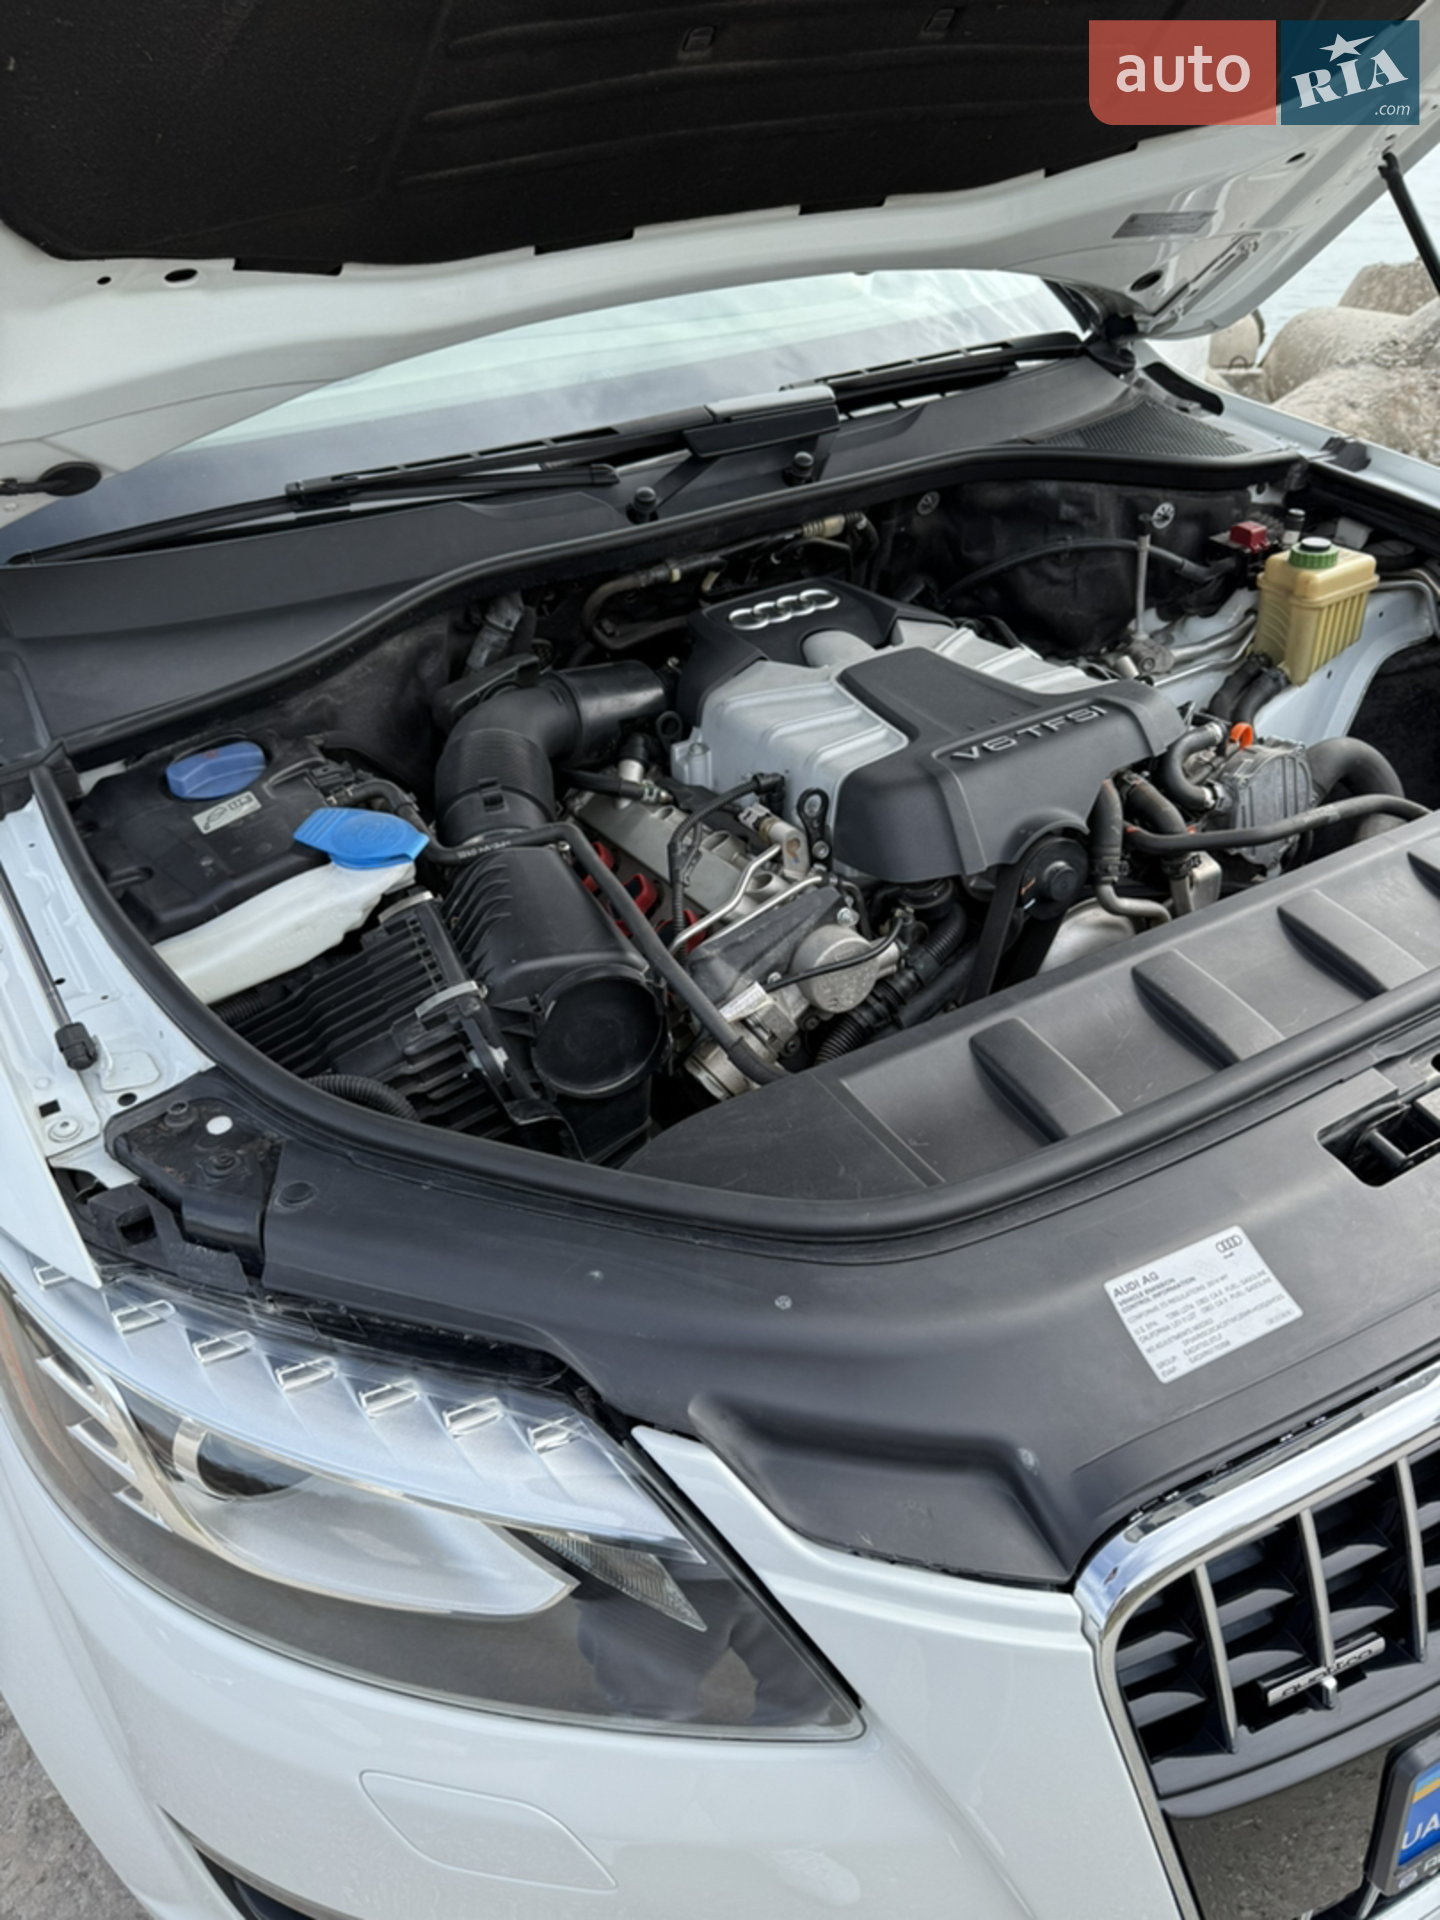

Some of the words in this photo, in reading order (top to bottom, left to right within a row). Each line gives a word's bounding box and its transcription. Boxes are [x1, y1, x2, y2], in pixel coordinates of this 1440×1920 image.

[949, 734, 1018, 761] V6
[1016, 704, 1108, 739] TFSI
[1110, 1278, 1141, 1299] AUDI
[1139, 1270, 1161, 1286] AG
[1401, 1812, 1440, 1850] UA
